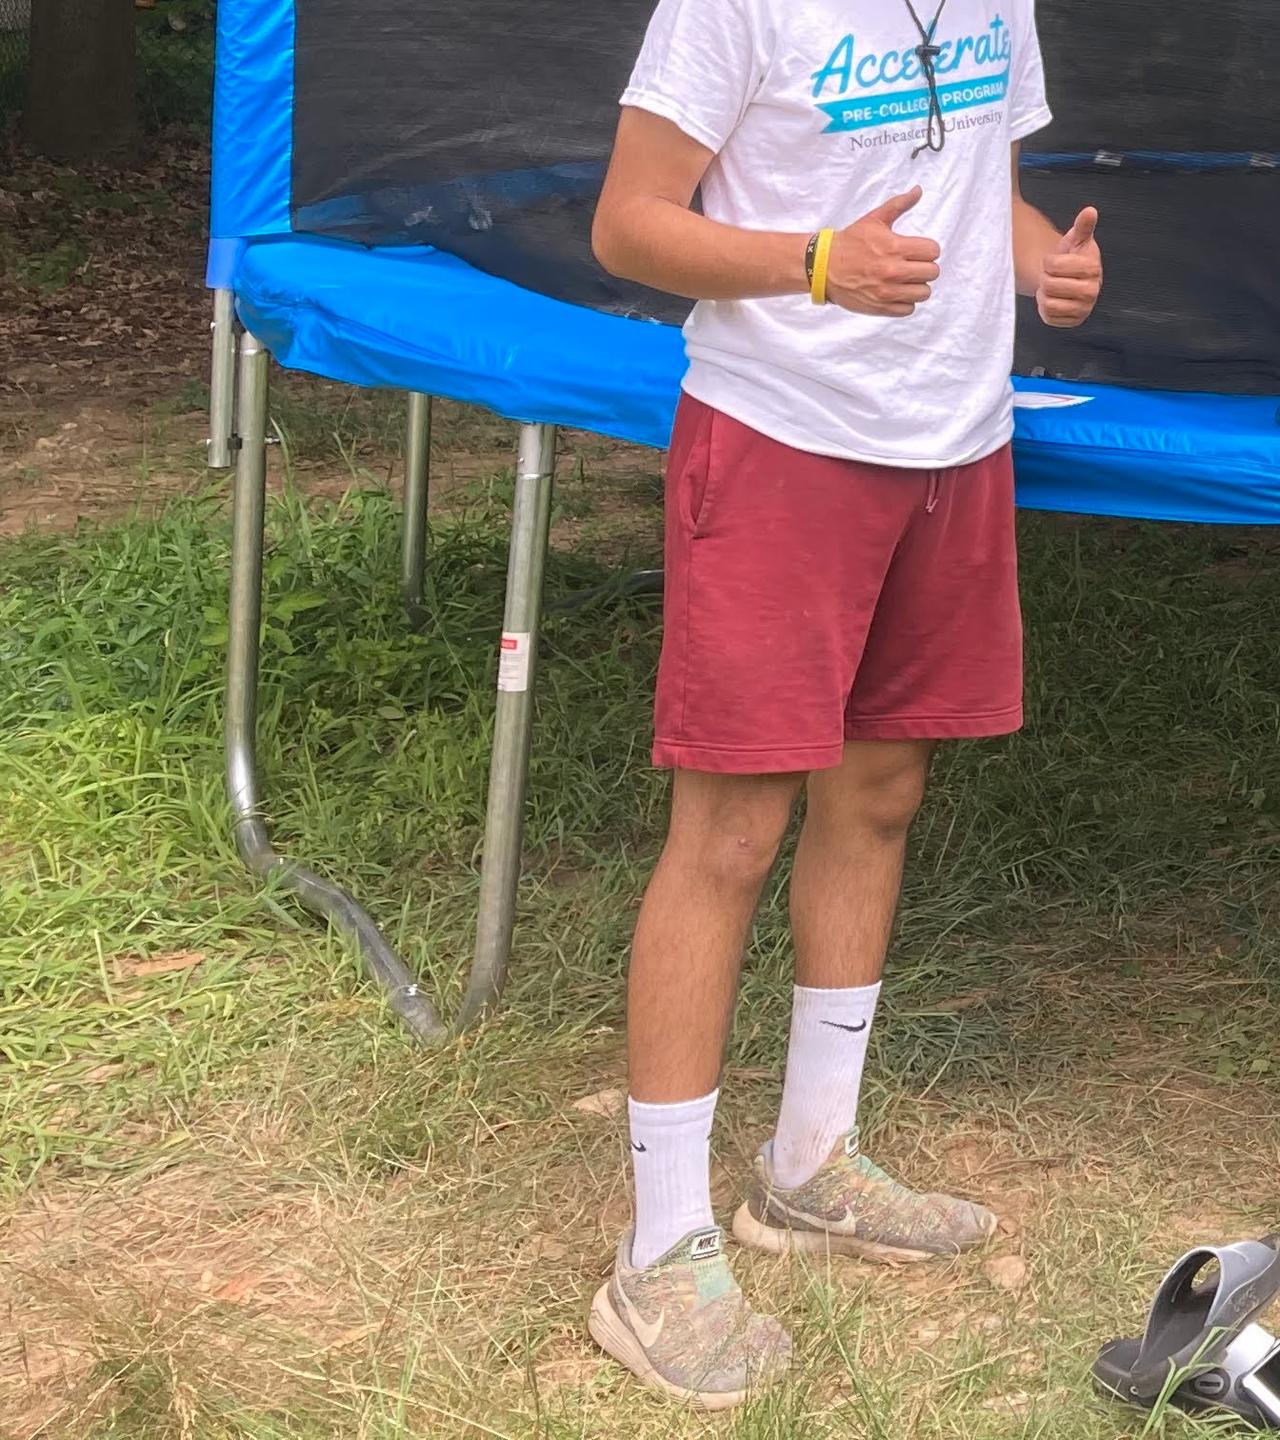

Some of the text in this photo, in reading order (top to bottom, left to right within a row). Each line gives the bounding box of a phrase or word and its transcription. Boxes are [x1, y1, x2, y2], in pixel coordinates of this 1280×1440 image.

[842, 96, 932, 124] PRE-COLLEG
[849, 110, 1004, 152] Northeastern University
